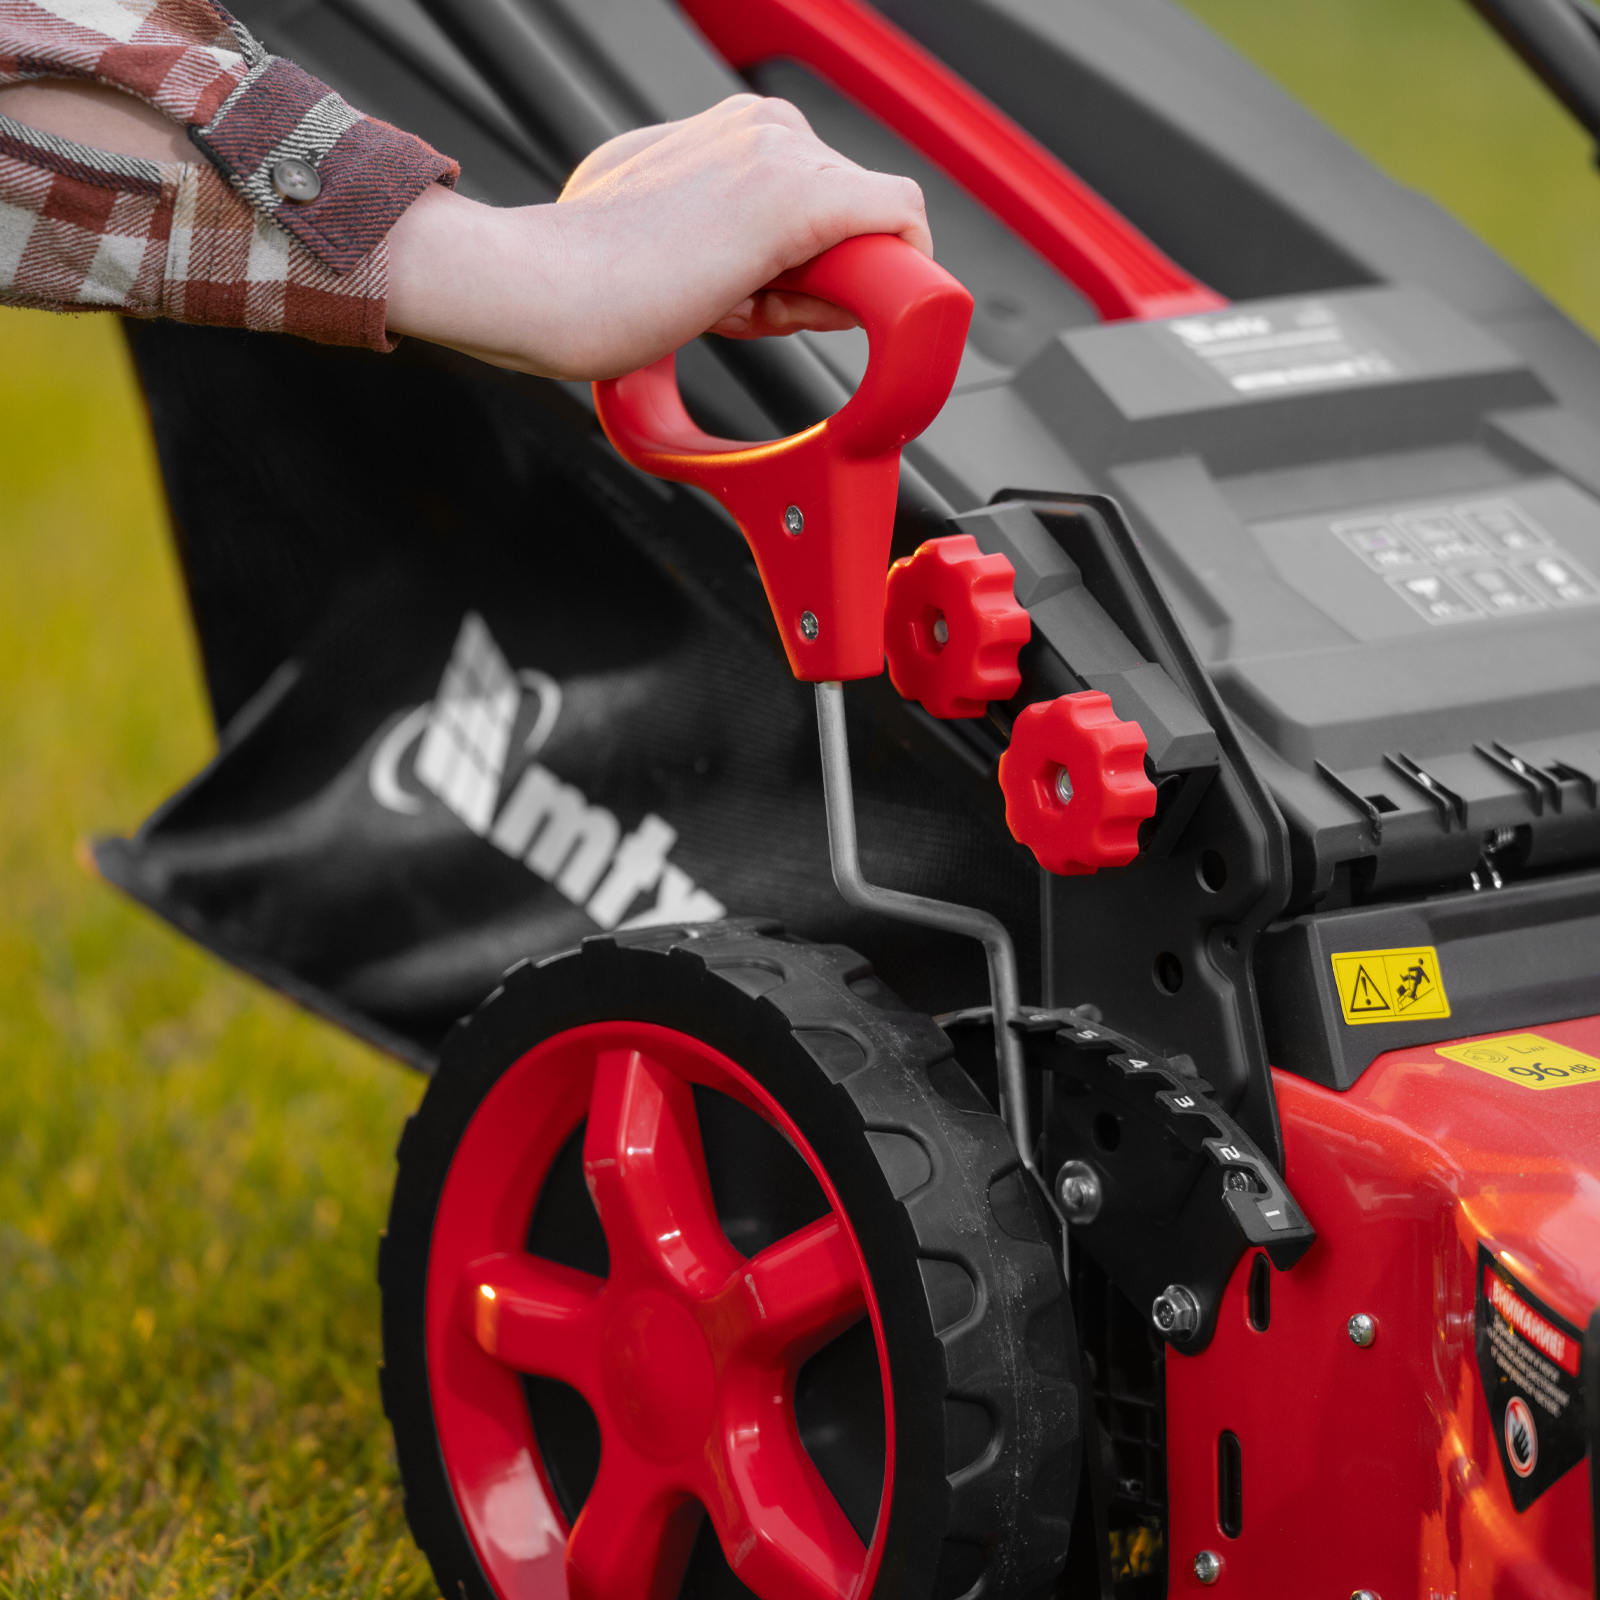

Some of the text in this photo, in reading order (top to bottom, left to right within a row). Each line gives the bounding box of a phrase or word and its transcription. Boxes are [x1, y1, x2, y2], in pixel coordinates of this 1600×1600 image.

[1077, 1030, 1100, 1039] 5
[1128, 1059, 1149, 1069] 4
[1508, 1062, 1597, 1082] 96 dB
[1174, 1095, 1196, 1108] 3
[1219, 1145, 1241, 1161] 2
[1265, 1209, 1281, 1217] 1
